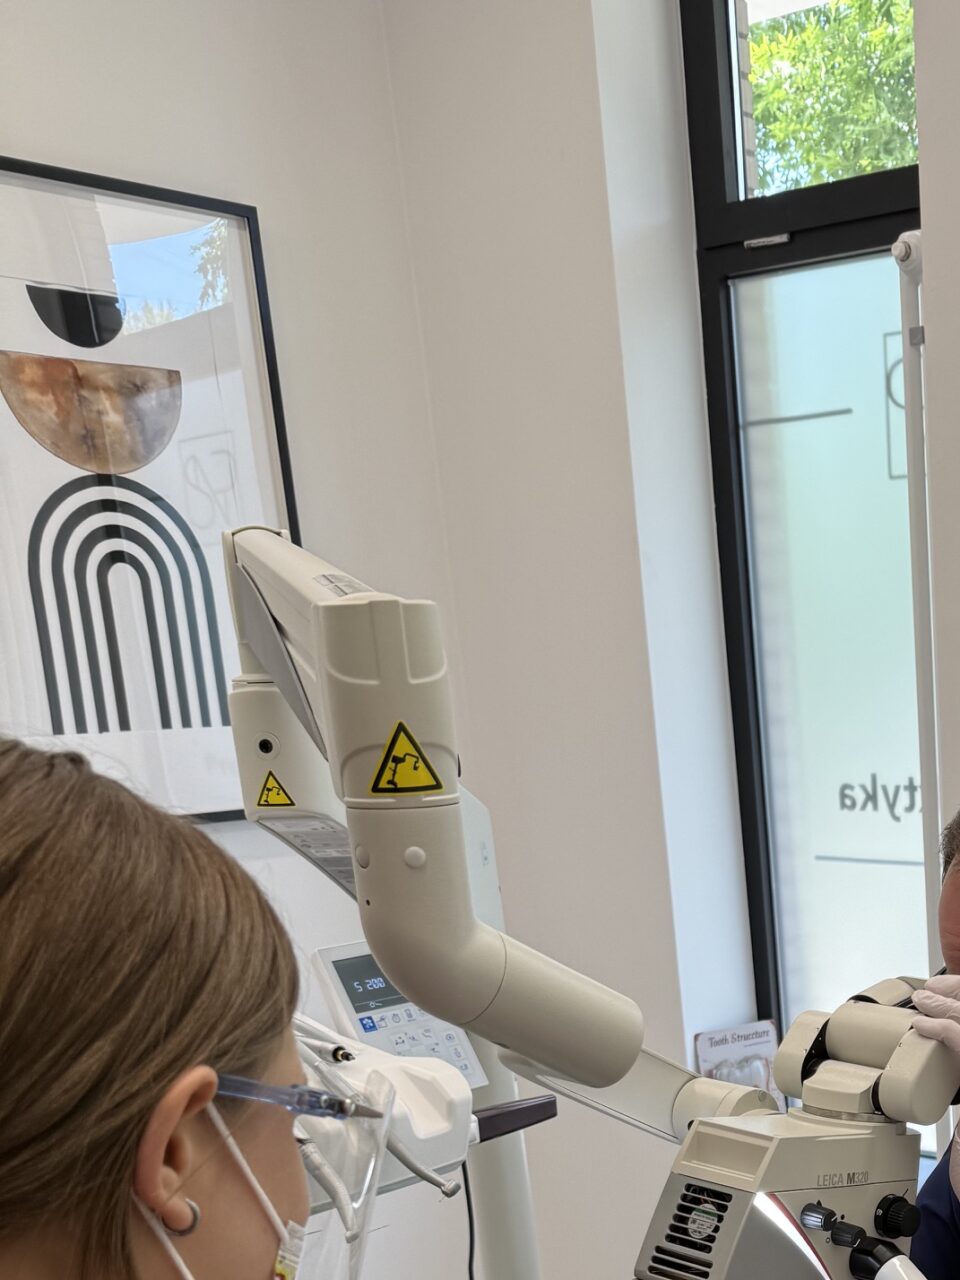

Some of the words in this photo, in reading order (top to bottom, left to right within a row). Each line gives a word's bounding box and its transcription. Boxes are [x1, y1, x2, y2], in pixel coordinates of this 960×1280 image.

[708, 1033, 730, 1049] Tooth
[730, 1029, 770, 1044] Structure
[817, 1173, 844, 1187] LEICA
[846, 1170, 869, 1185] M320
